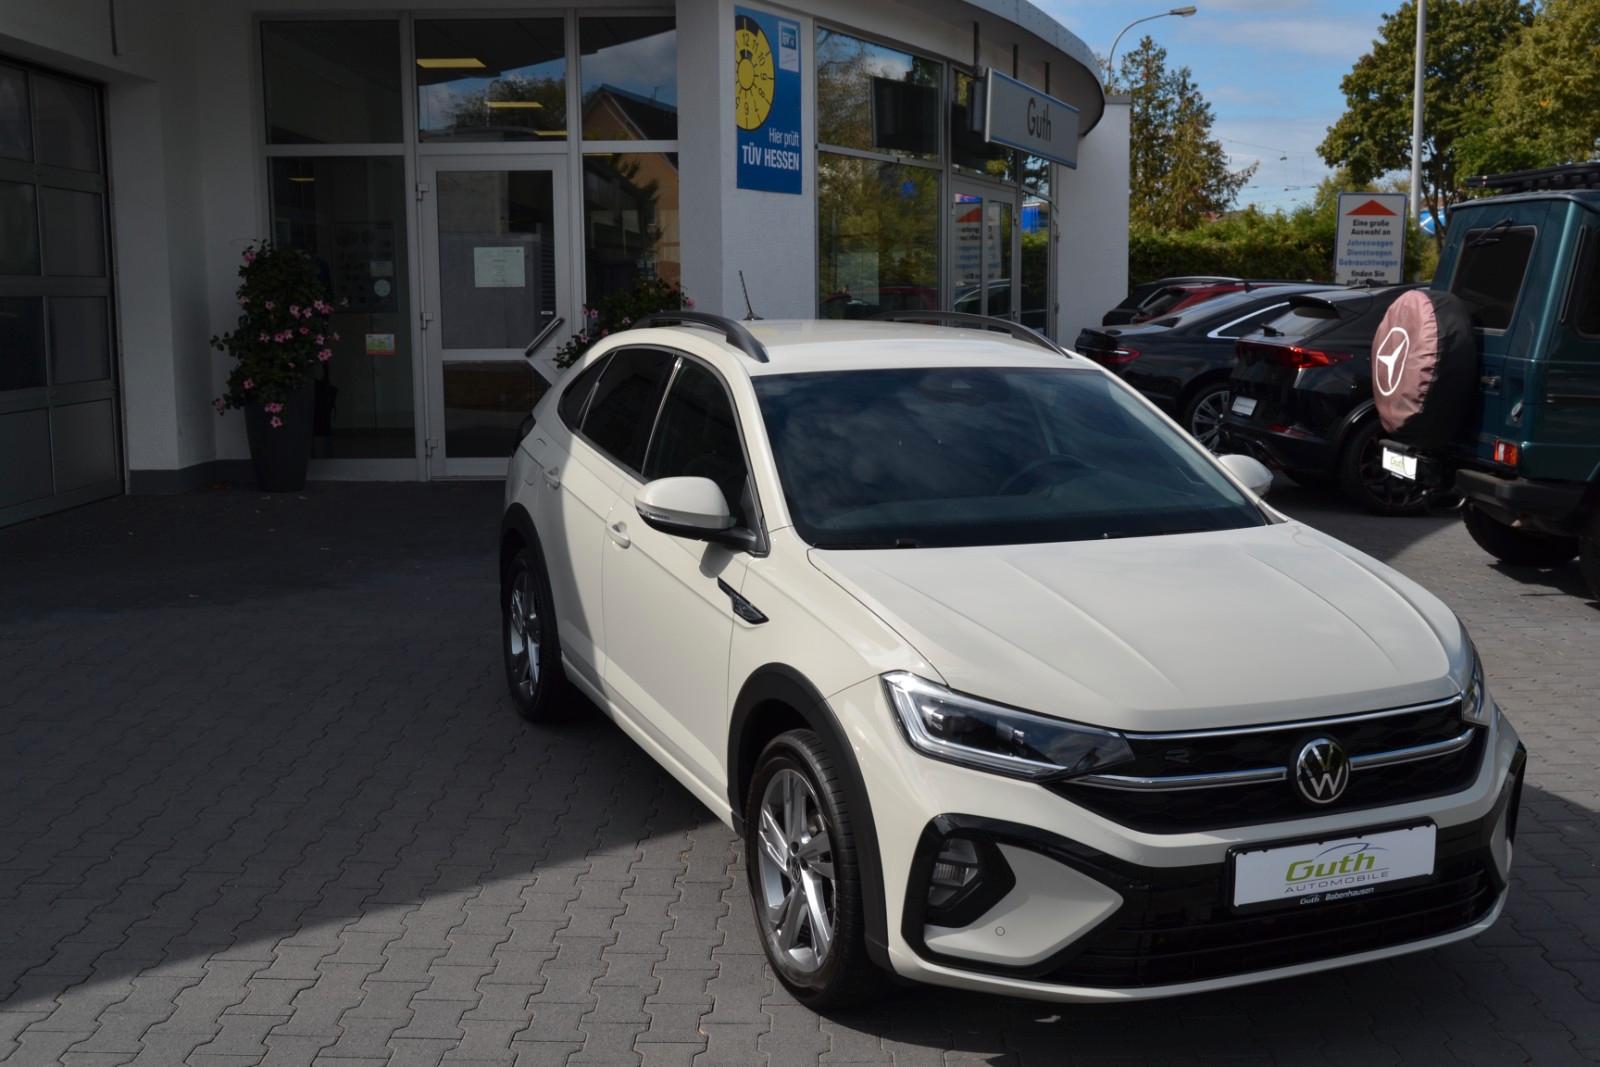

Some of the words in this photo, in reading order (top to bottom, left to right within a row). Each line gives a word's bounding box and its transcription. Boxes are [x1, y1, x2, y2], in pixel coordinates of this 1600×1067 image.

[742, 33, 749, 47] 12
[1026, 96, 1052, 142] Guth
[768, 127, 783, 145] Hier
[783, 130, 799, 148] prüft
[742, 142, 761, 165] TÜV
[764, 147, 799, 171] HESSEN
[1353, 219, 1368, 227] Eine
[1351, 228, 1381, 236] Auswahl
[1346, 240, 1394, 248] Jahreswagen
[1346, 249, 1392, 257] Dienstwagen
[1338, 259, 1398, 267] Gebrauchtwagen
[1285, 852, 1376, 882] Guth
[1284, 871, 1389, 894] AUTOMOBILE
[1299, 895, 1322, 906] Guth
